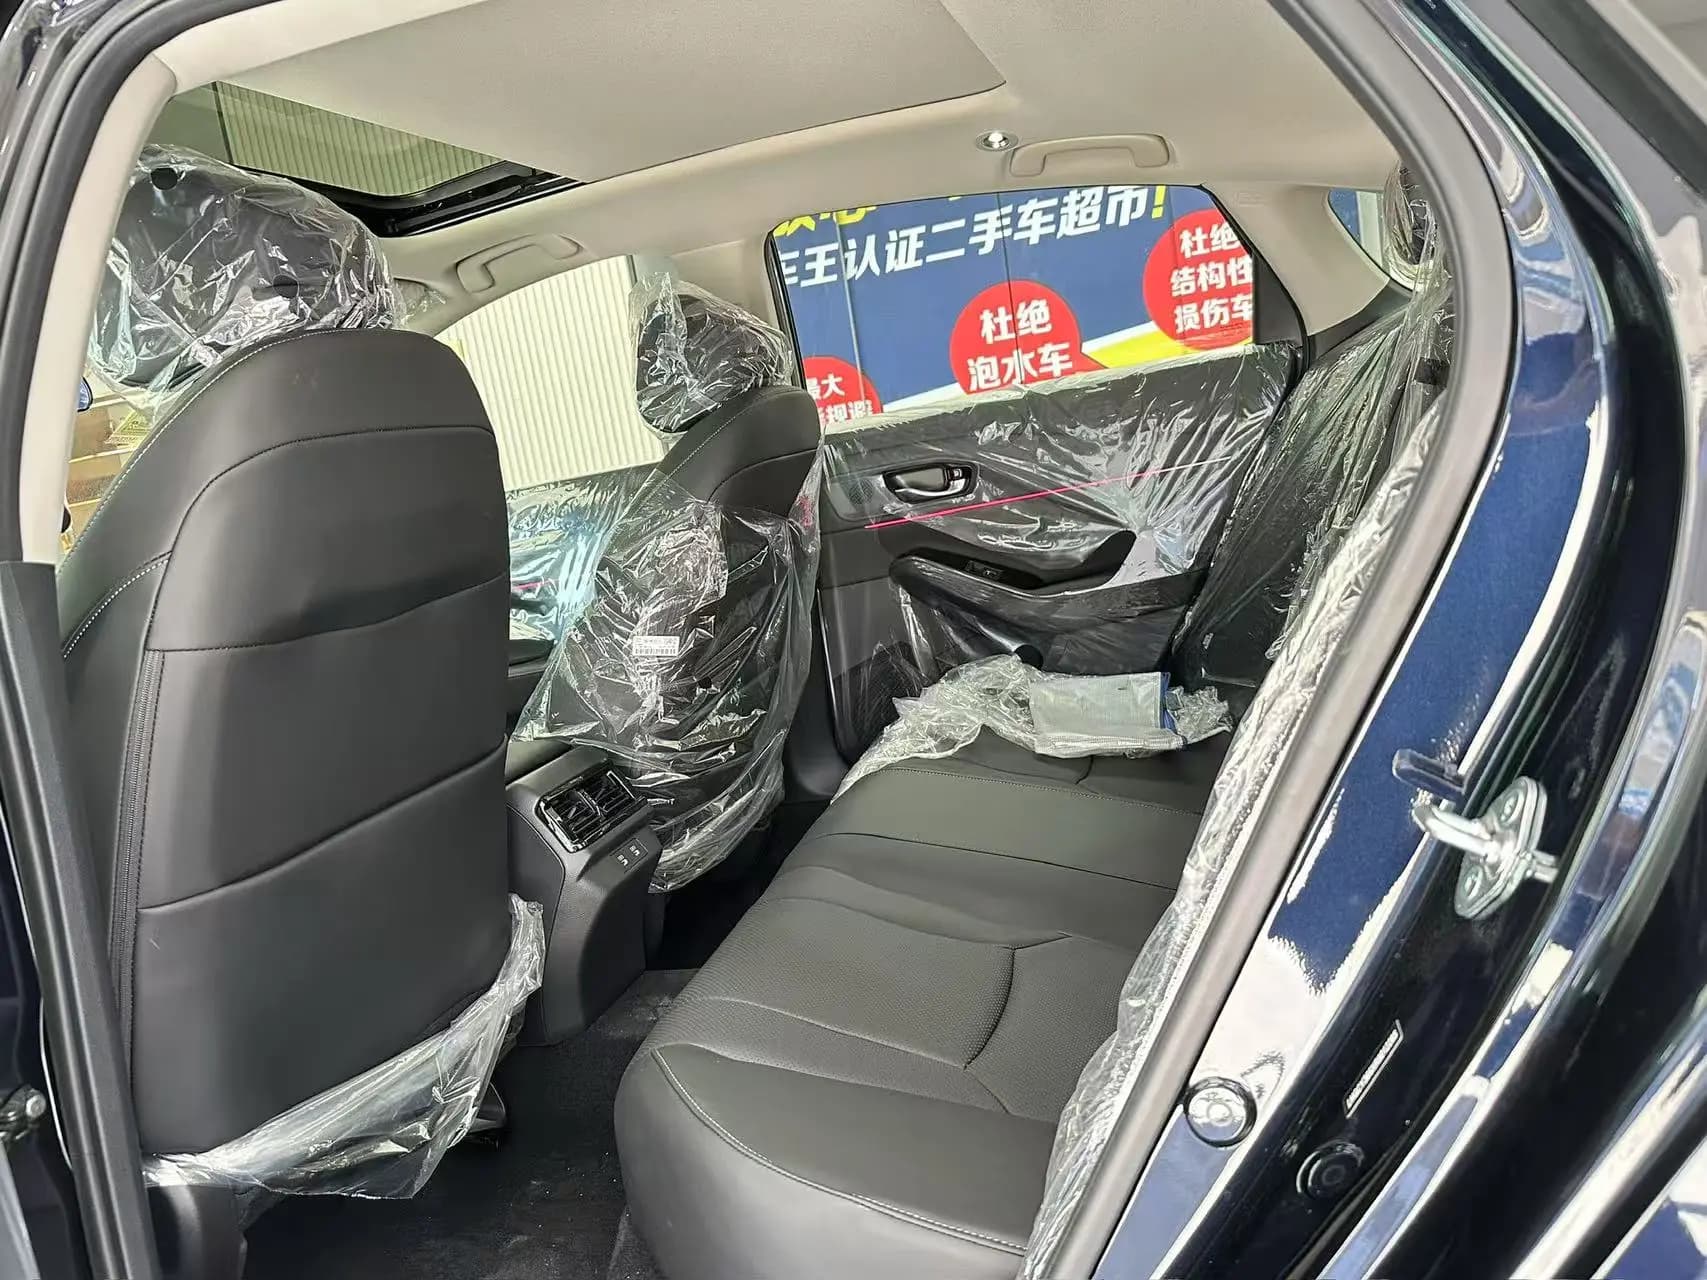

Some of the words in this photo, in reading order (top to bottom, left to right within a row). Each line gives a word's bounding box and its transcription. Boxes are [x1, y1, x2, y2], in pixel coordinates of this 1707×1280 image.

[1180, 222, 1240, 258] 杜绝
[1170, 255, 1252, 297] 结构性
[980, 299, 1052, 344] 杜绝
[1173, 294, 1252, 334] 损伤车
[967, 342, 1072, 391] 泡水车
